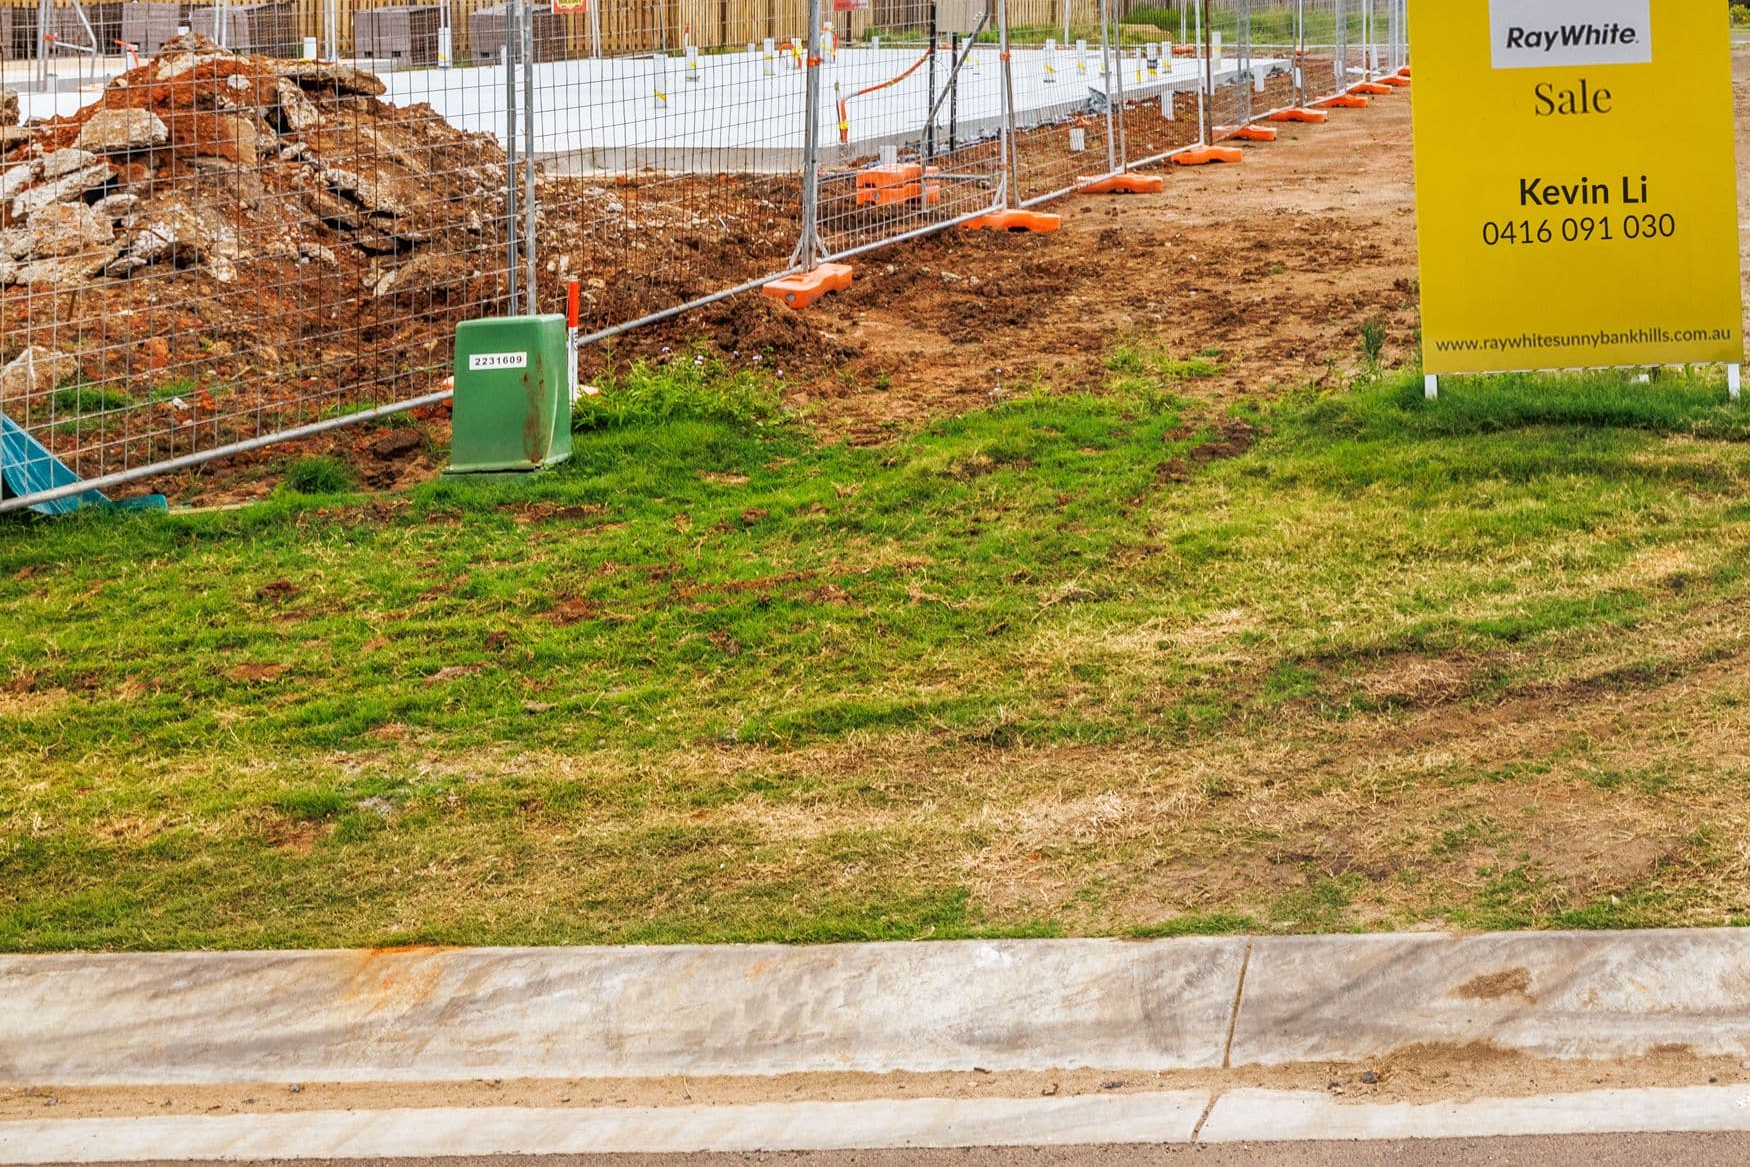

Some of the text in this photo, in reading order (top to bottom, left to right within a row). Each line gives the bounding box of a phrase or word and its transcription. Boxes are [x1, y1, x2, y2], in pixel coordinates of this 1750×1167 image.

[1534, 78, 1612, 117] Sale
[1519, 175, 1648, 206] Kevin Li
[1482, 213, 1676, 246] 0416 091 030
[1435, 327, 1731, 353] www.raywhitesunnybankhills.com.au
[474, 355, 522, 367] 2231609
